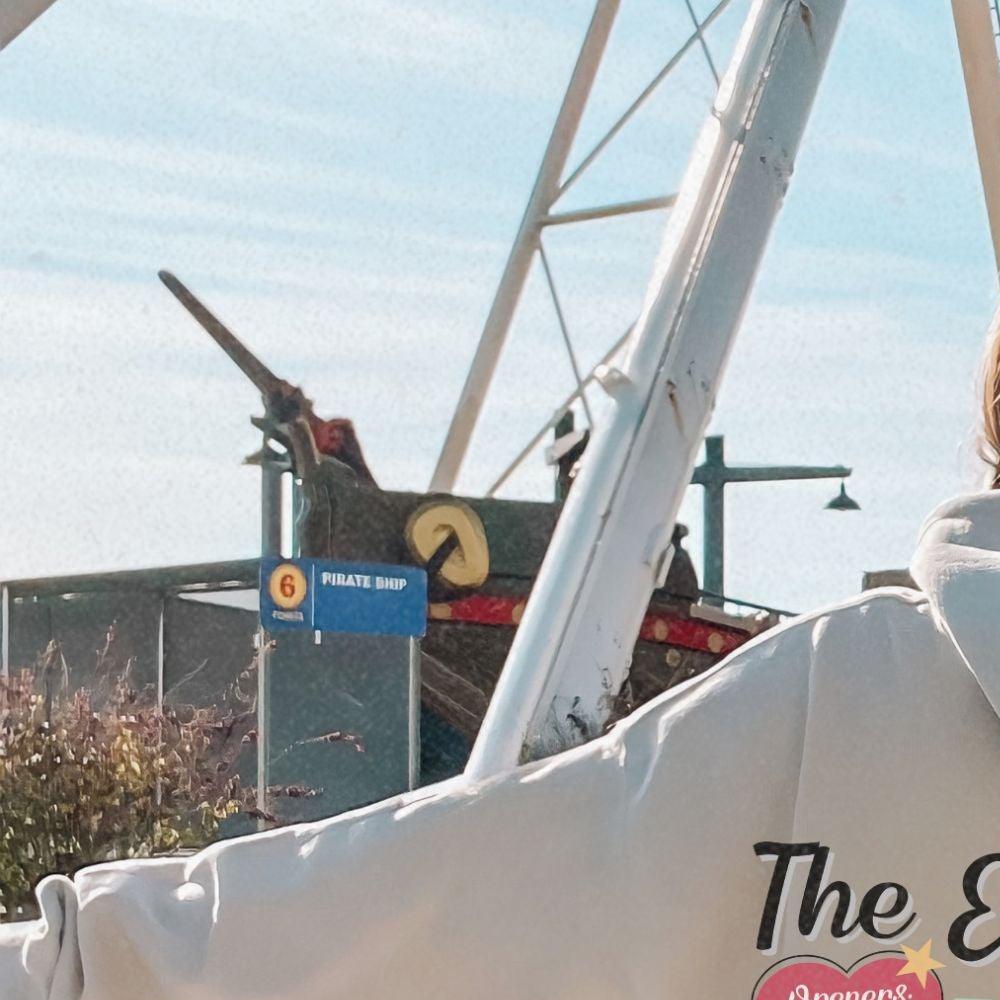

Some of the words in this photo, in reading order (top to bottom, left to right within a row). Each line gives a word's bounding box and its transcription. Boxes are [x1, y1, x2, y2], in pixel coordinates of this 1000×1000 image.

[280, 574, 296, 598] 6
[322, 571, 371, 589] PIRATE
[753, 841, 919, 952] The
